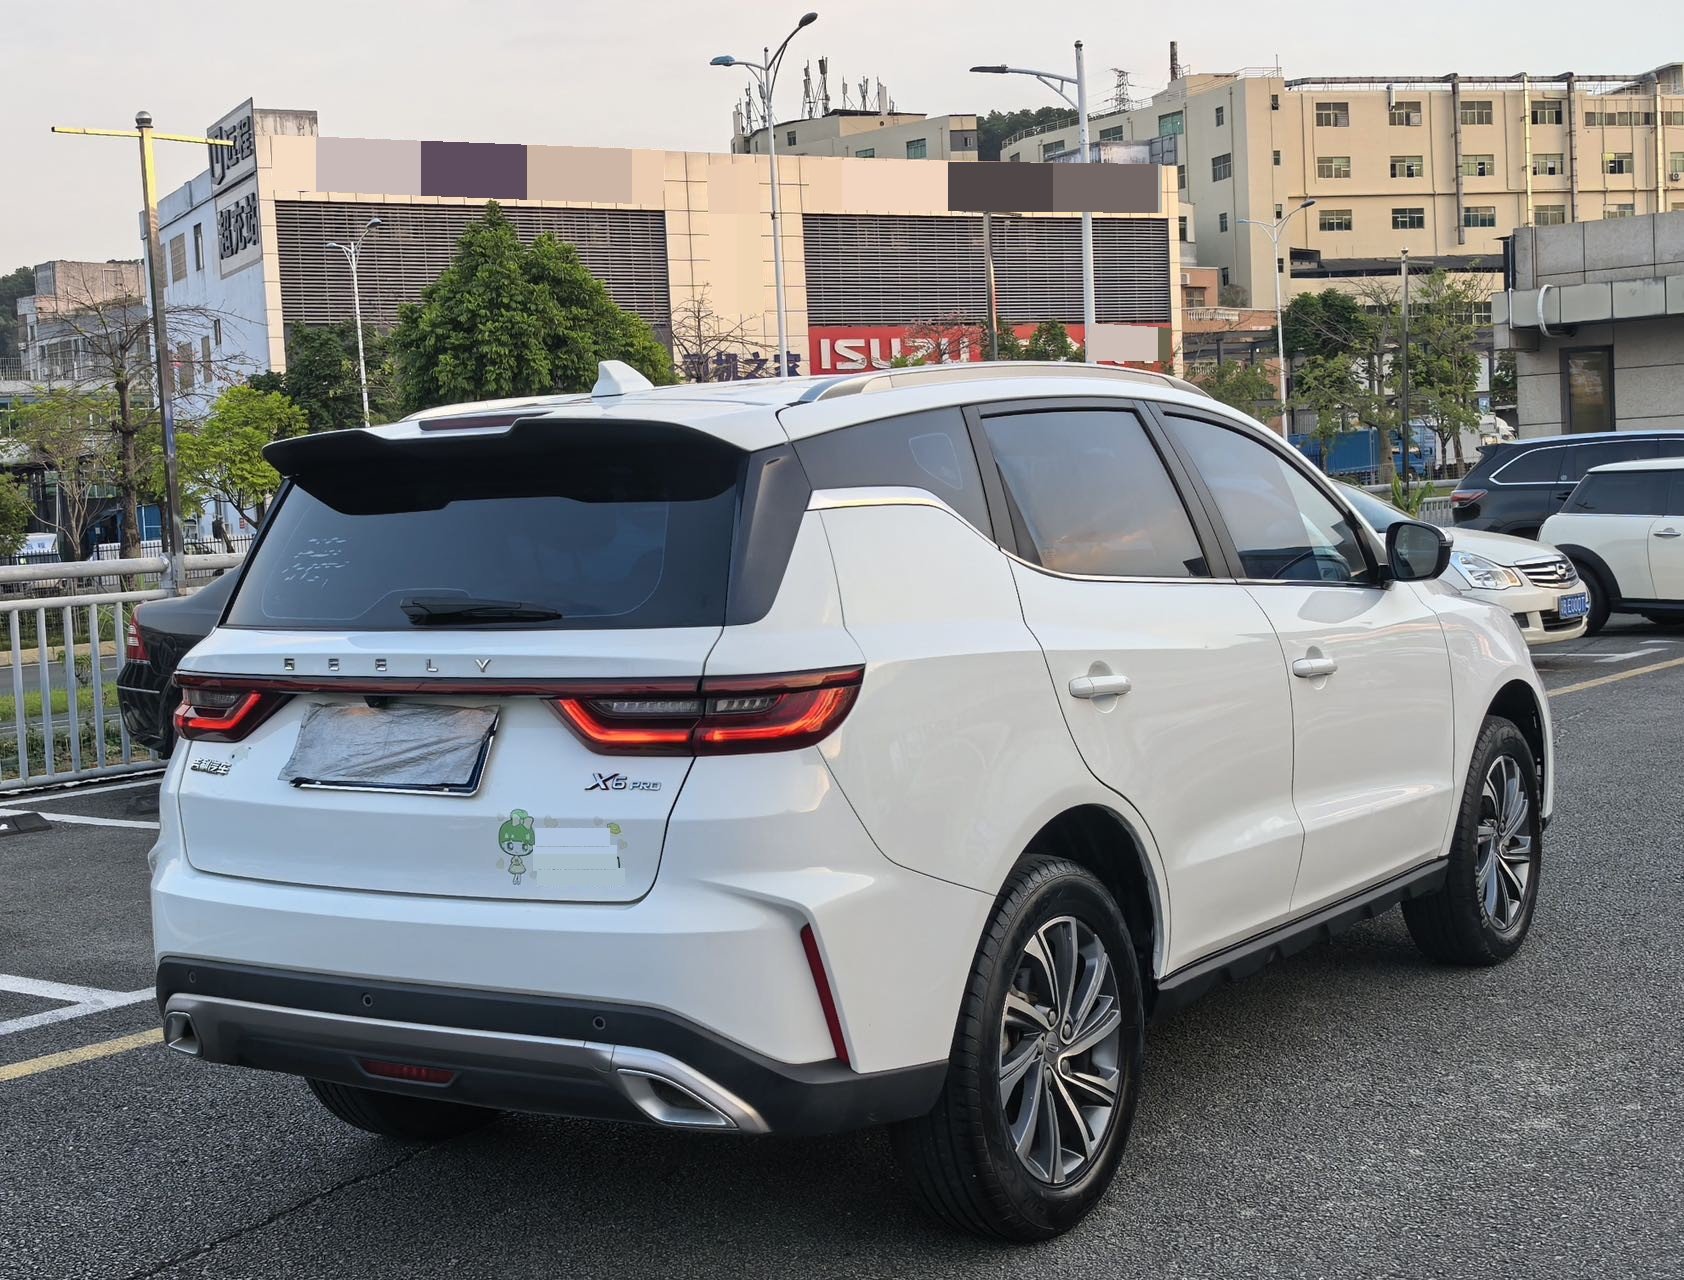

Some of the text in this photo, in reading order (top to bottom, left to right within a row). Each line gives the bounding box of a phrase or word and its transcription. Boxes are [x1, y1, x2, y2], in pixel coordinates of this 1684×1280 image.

[284, 658, 491, 672] GEELY
[585, 772, 662, 792] X6 PRO
